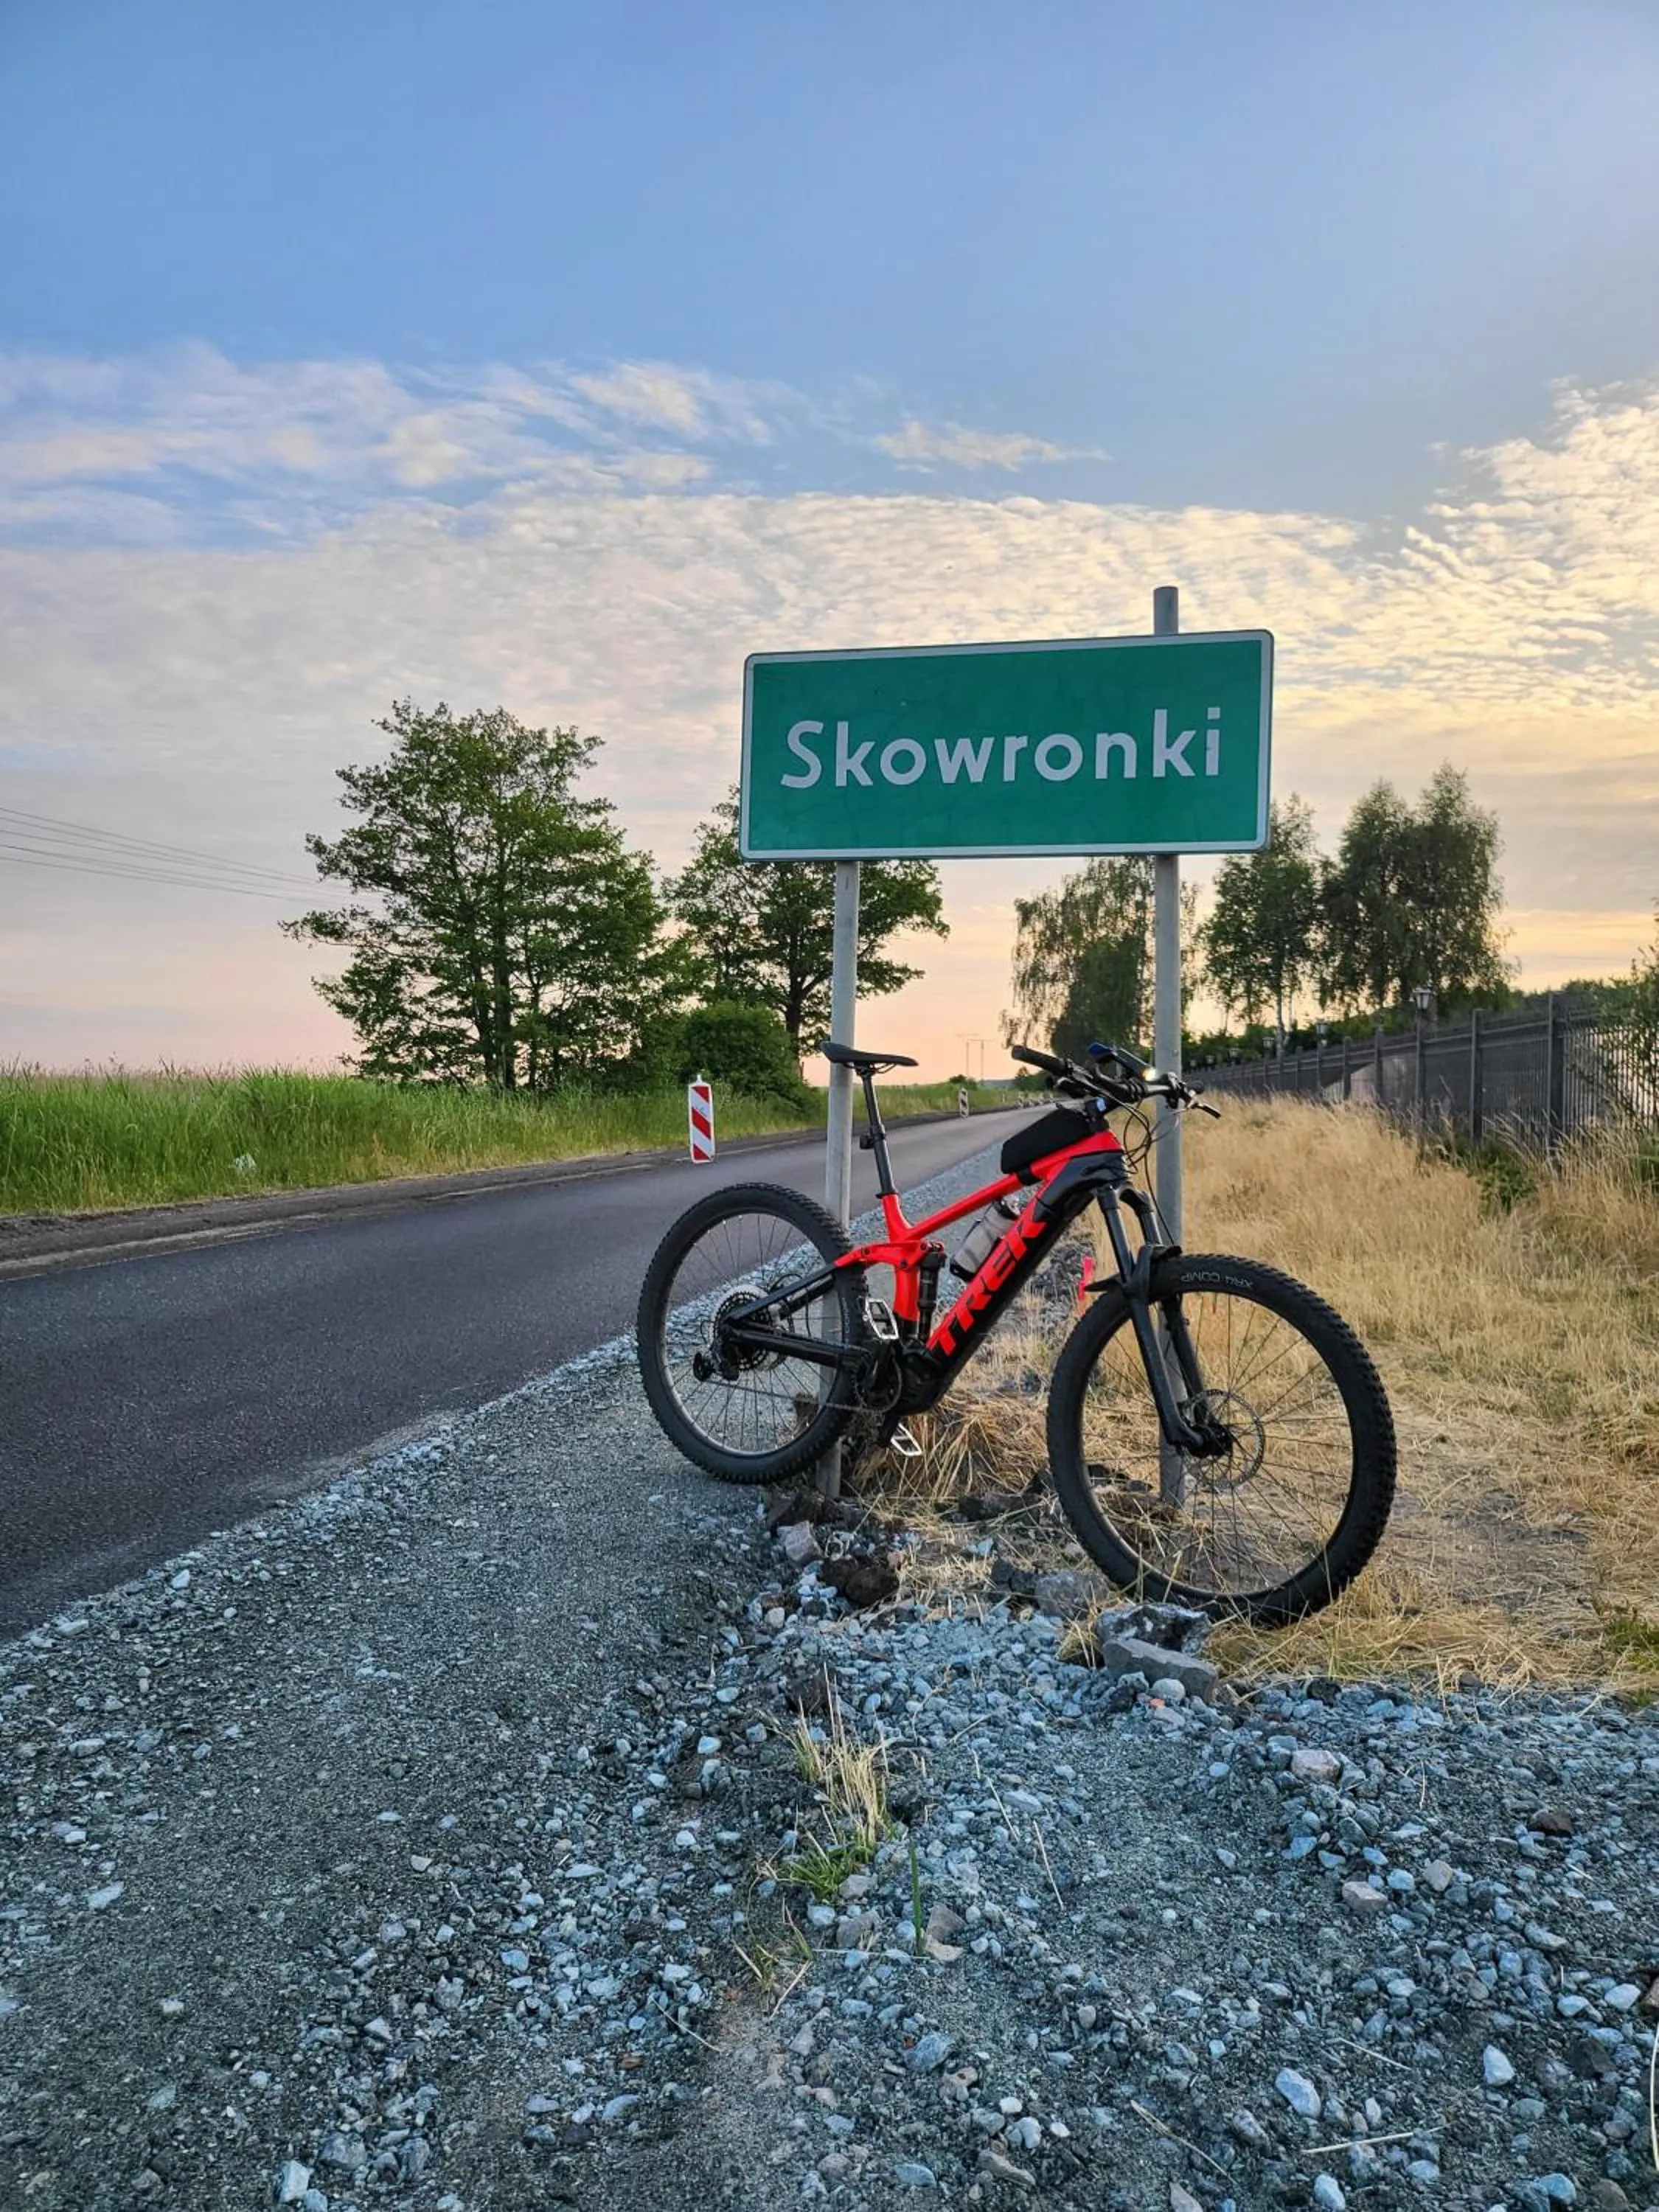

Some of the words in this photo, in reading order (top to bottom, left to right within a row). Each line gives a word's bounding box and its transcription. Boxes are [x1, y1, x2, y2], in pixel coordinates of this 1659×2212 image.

[781, 707, 1221, 788] Skowronki
[925, 1207, 1047, 1356] TREK
[1181, 1272, 1220, 1282] COMP
